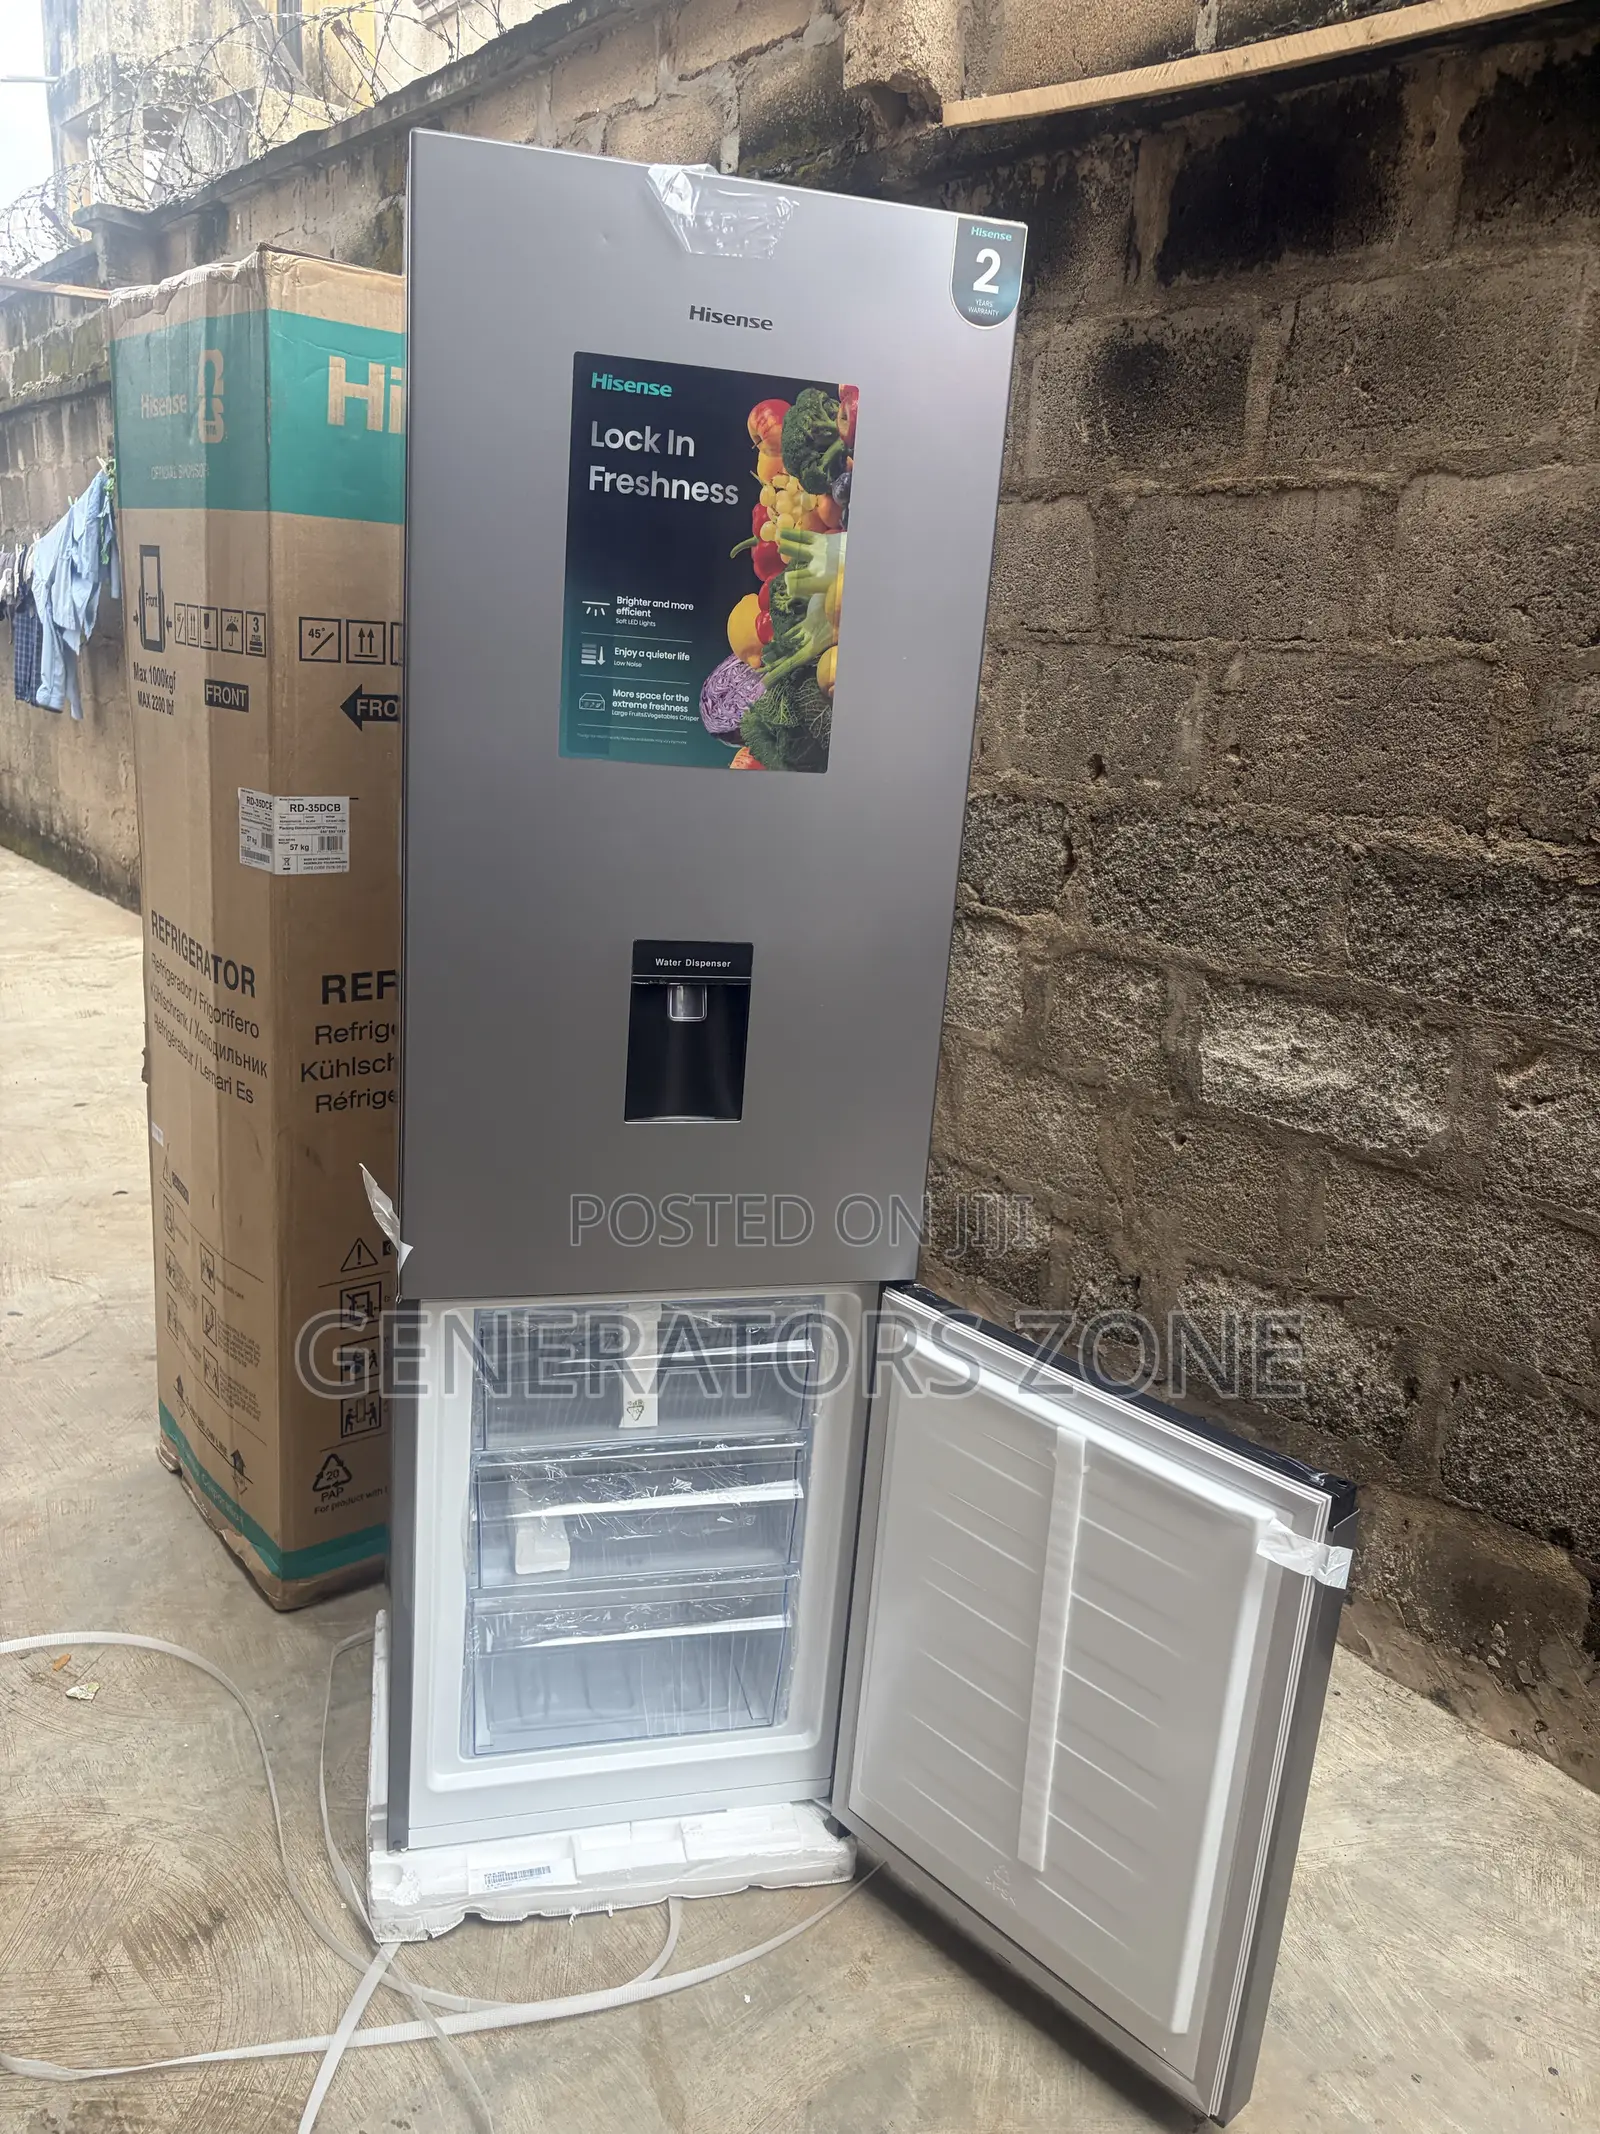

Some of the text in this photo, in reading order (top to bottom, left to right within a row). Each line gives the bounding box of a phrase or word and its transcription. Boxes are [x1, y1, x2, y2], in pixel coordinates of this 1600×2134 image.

[970, 226, 1012, 242] Hisense
[972, 248, 1001, 295] 2
[976, 299, 993, 307] YEARS
[689, 304, 773, 331] Hisense
[590, 372, 672, 398] Hisense
[141, 392, 187, 420] Hisense
[590, 420, 695, 457] Lock In
[588, 464, 739, 506] Freshness
[616, 596, 694, 610] Brighter and more
[616, 607, 651, 617] efficient
[252, 616, 260, 633] 3
[614, 647, 637, 658] Enjoy
[646, 650, 676, 660] quieter
[677, 652, 690, 661] life
[133, 661, 147, 682] Max
[138, 690, 151, 709] MAX
[206, 684, 247, 707] FRONT
[612, 688, 689, 702] More space for the
[611, 709, 628, 717] Large
[612, 700, 688, 712] extreme freshness
[289, 803, 341, 813] RD-35DCB
[300, 844, 310, 852] kg
[151, 909, 256, 999] REFRIGERATOR
[655, 957, 731, 969] Water Dispenser
[321, 969, 398, 1005] REF
[199, 990, 259, 1039] Frigorifero
[200, 1055, 232, 1095] Lemari
[237, 1080, 254, 1104] Es
[326, 1469, 340, 1481] 20
[320, 1486, 344, 1503] PAP
[314, 1504, 330, 1515] For
